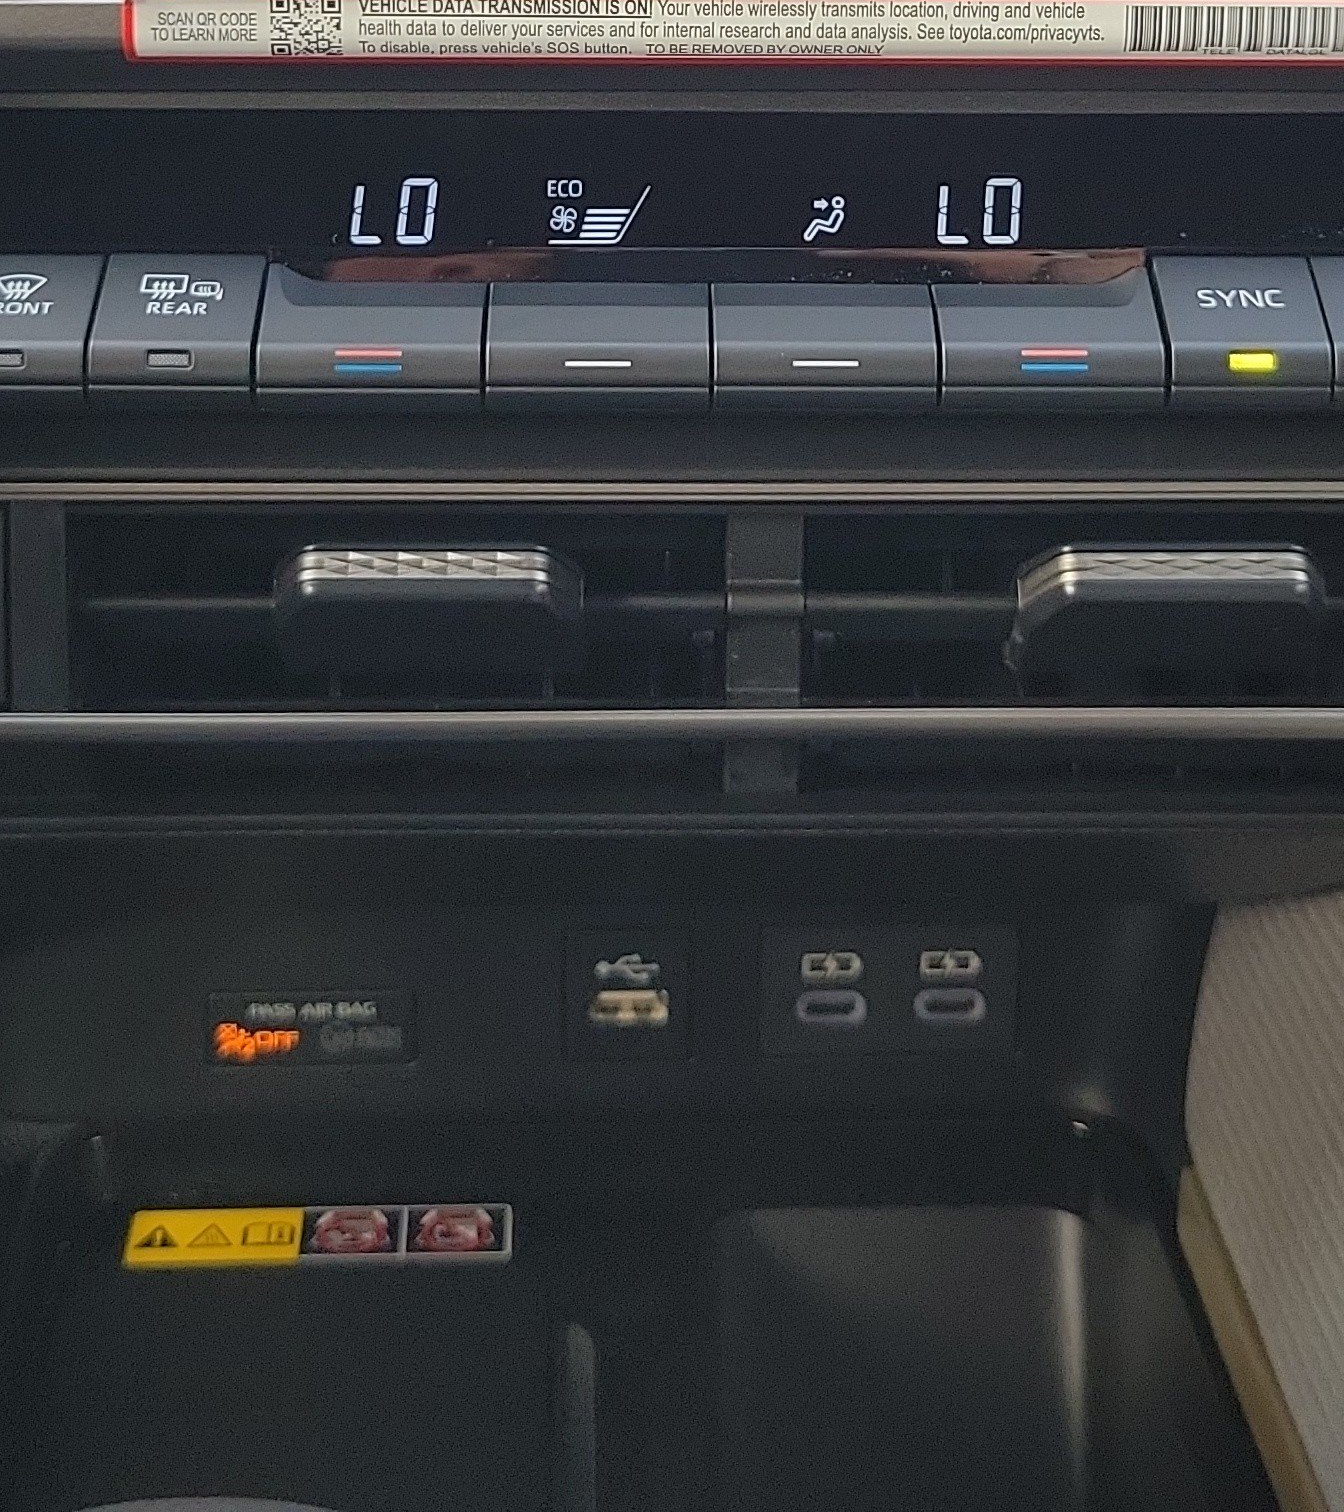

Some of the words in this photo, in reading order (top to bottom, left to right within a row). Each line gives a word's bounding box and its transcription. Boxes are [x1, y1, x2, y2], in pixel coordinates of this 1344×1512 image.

[158, 12, 194, 27] SCAN
[197, 12, 217, 27] QR
[219, 12, 257, 27] CODE
[478, 0, 601, 15] TRANSMISSION
[605, 0, 622, 15] IS
[624, 0, 653, 16] ON!
[656, 1, 691, 17] Your
[694, 1, 744, 17] vehicle
[747, 1, 817, 21] wirelessly
[821, 1, 886, 17] transmits
[889, 1, 949, 19] location,
[953, 2, 1000, 22] driving
[1004, 2, 1031, 19] and
[1035, 2, 1086, 19] vehicle
[151, 28, 170, 42] TO
[171, 28, 216, 42] LEARN
[218, 28, 258, 42] MORE
[358, 19, 402, 37] health
[406, 19, 437, 37] data
[441, 21, 456, 37] to
[460, 20, 507, 37] deliver
[511, 24, 542, 40] your
[545, 21, 605, 38] services
[609, 21, 637, 38] and
[640, 21, 659, 38] for
[662, 21, 716, 39] internal
[719, 22, 781, 40] research
[785, 22, 812, 40] and
[816, 22, 847, 40] data
[851, 22, 913, 44] analysis.
[917, 24, 945, 41] See
[949, 23, 1106, 45] toyota.com/privacyvts.
[358, 40, 376, 54] To
[379, 40, 435, 56] disable,
[439, 43, 477, 55] press
[481, 41, 543, 54] vehicle's
[546, 41, 581, 54] SOS
[584, 41, 633, 55] button.
[646, 43, 665, 55] TO
[668, 43, 688, 55] BE
[691, 43, 764, 55] REMOVED
[766, 44, 785, 55] BY
[788, 44, 844, 55] OWNER
[846, 44, 885, 55] ONLY
[1201, 47, 1236, 56] TELE
[546, 179, 584, 198] ECO
[1196, 288, 1286, 310] SYNC
[145, 301, 208, 316] REAR
[299, 1001, 333, 1021] AIR
